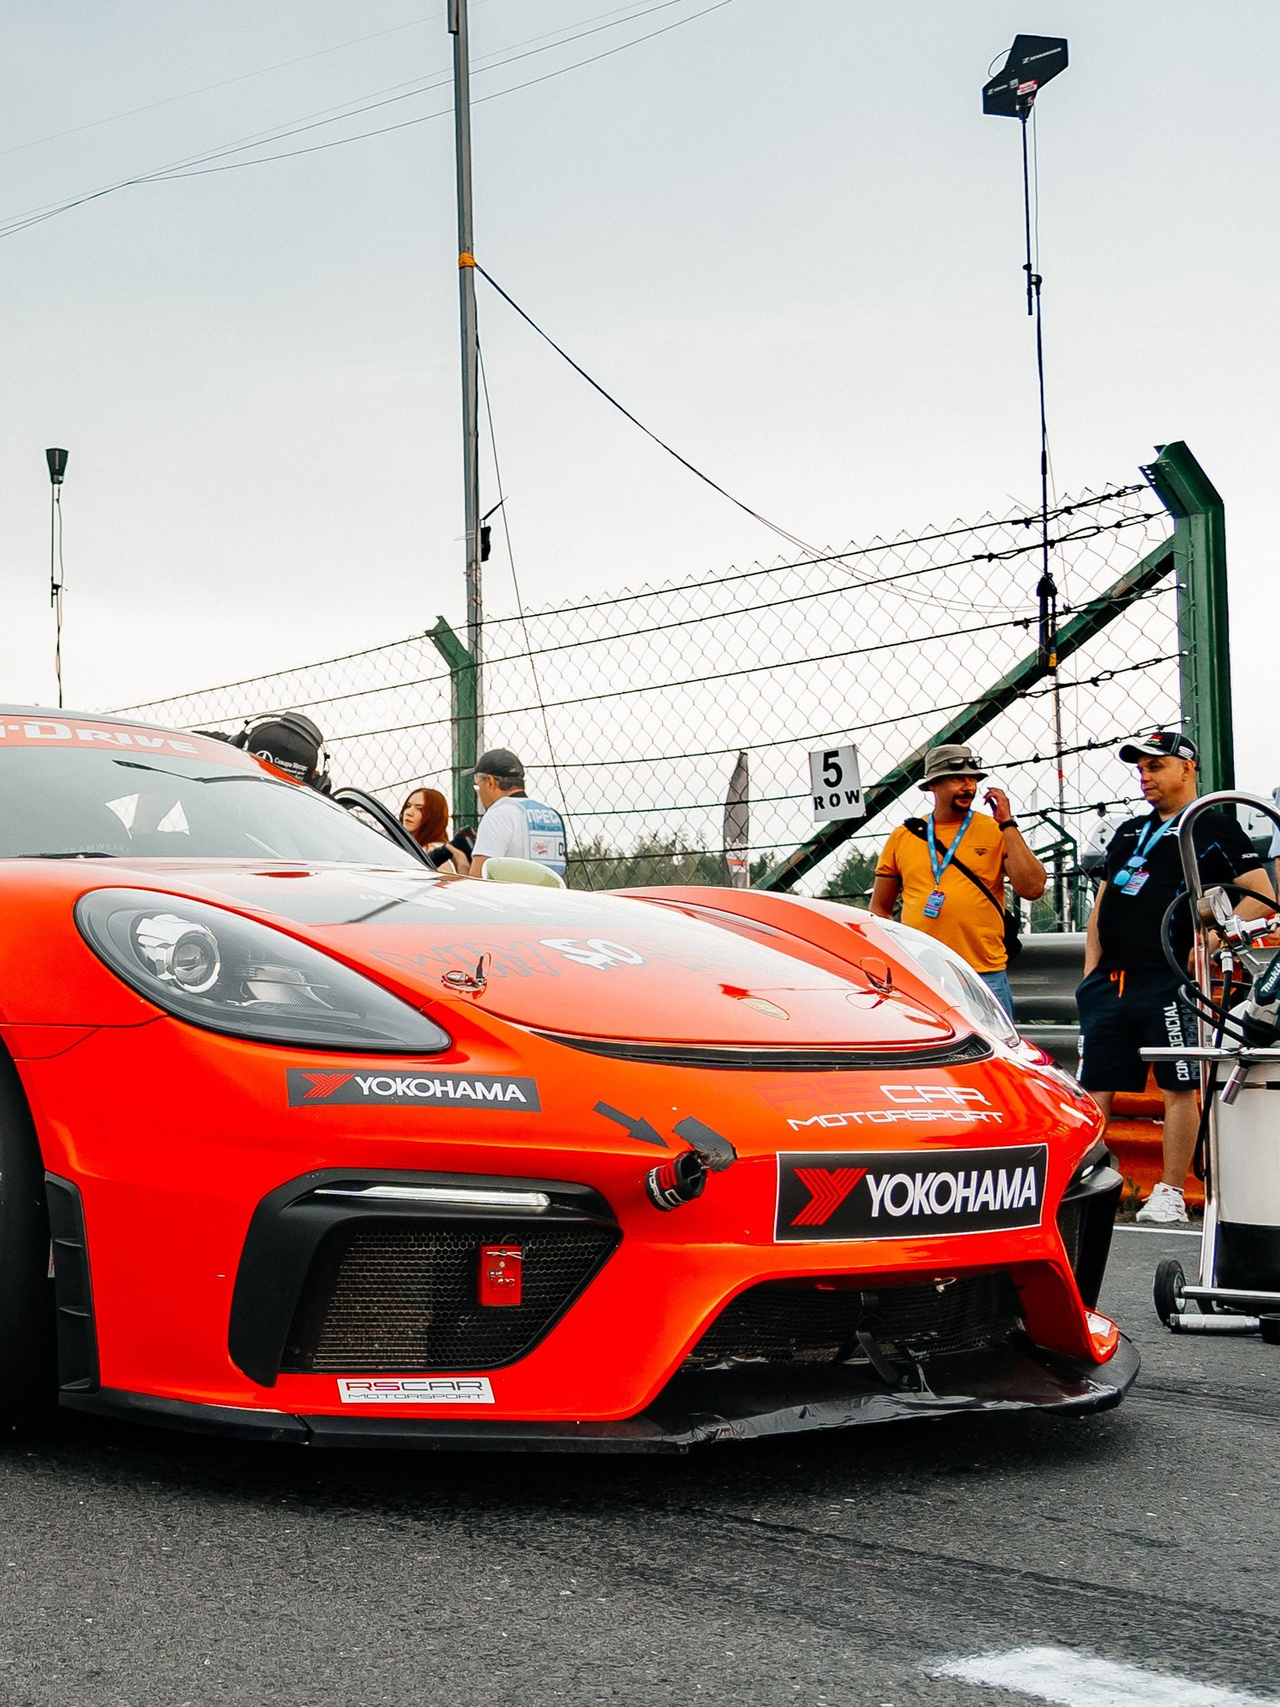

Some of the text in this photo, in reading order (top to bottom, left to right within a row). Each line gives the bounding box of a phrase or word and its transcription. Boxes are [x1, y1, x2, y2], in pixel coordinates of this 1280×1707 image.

[822, 749, 843, 788] 5
[813, 789, 860, 811] ROW
[527, 808, 562, 825] ПРЕС
[1163, 1001, 1191, 1081] CONDENCIAL
[354, 1075, 528, 1103] YOKOHAMA
[786, 1110, 1004, 1132] MOTORSPORT
[865, 1166, 1037, 1218] YOKOHAMA
[346, 1381, 483, 1391] RSCAR
